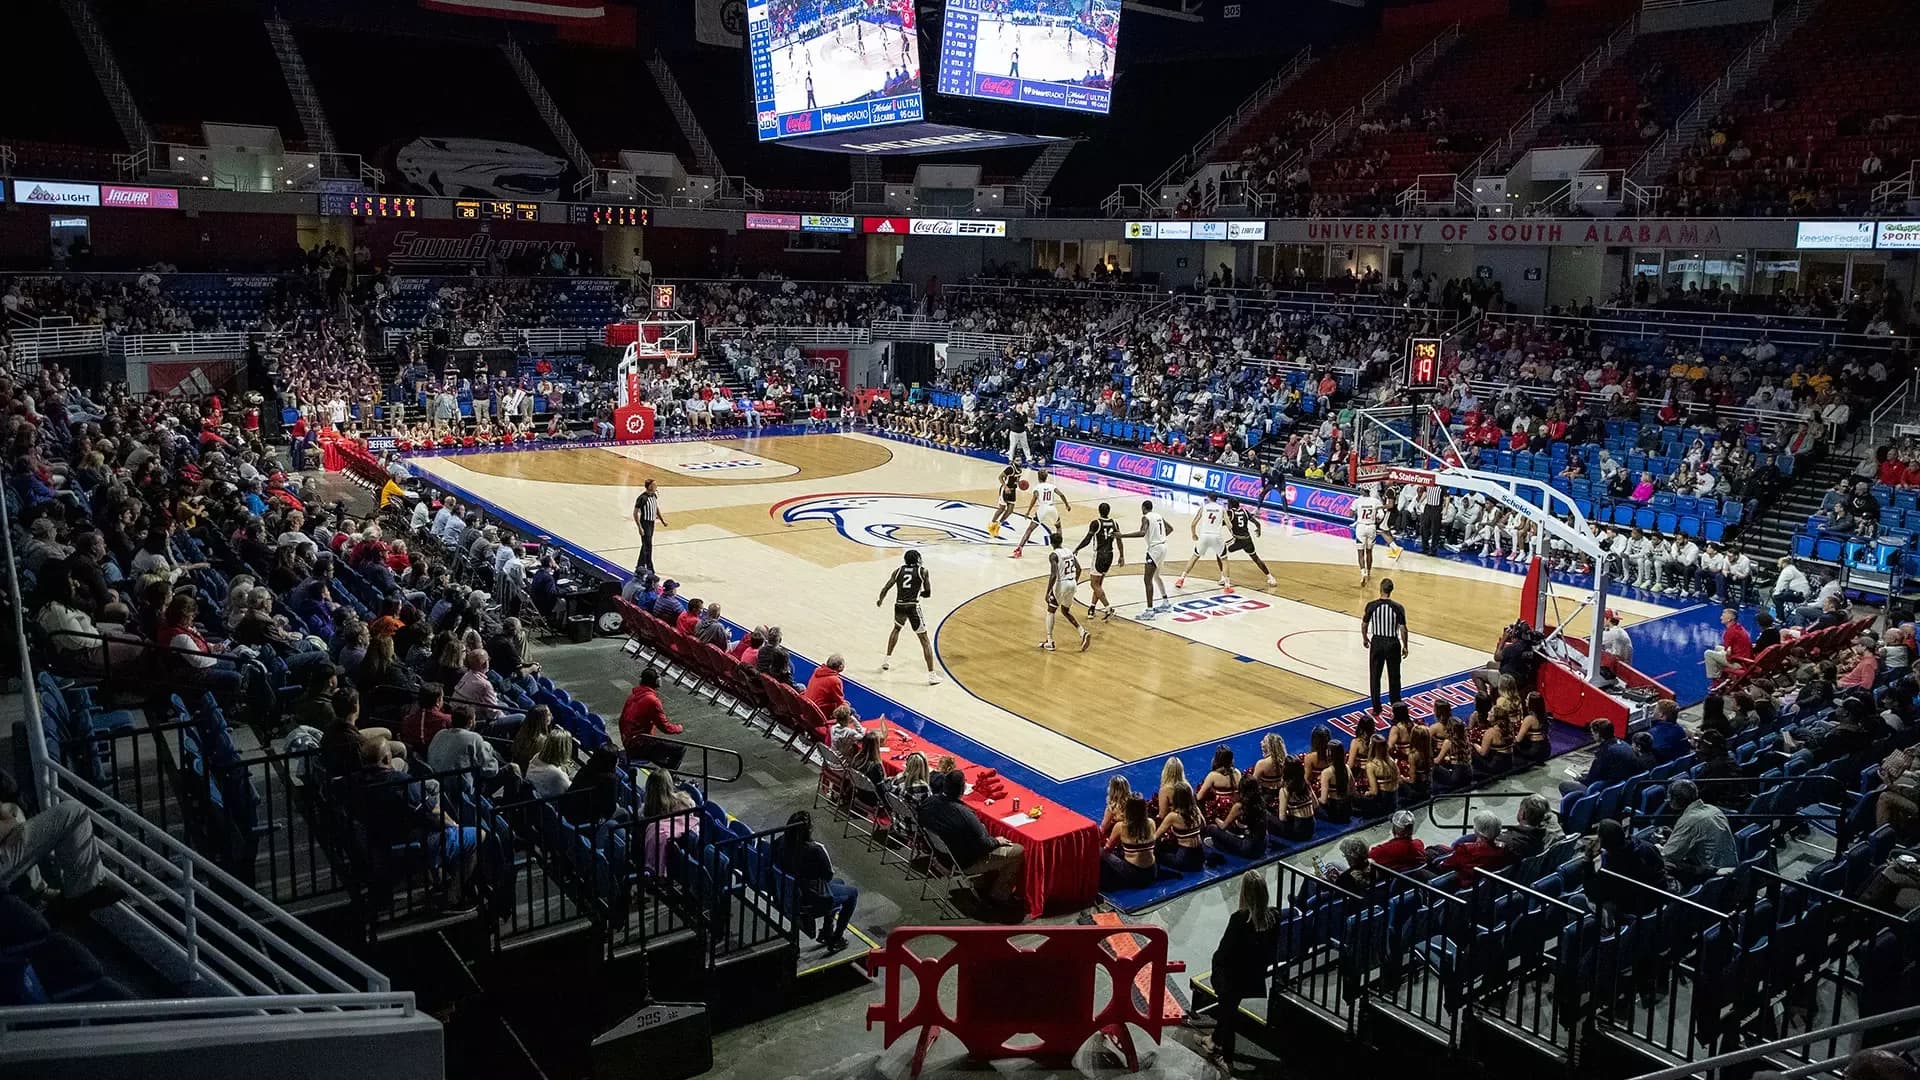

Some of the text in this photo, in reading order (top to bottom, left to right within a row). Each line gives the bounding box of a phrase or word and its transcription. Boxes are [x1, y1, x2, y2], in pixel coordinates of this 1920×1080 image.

[1225, 6, 1240, 17] 305
[981, 77, 1014, 96] Coca-Cola
[897, 97, 919, 110] ULTRA
[785, 113, 812, 133] Coca-Cola
[28, 190, 91, 203] Coors LIGHT
[105, 188, 150, 203] JAGUAR
[463, 208, 475, 217] 28
[490, 202, 512, 214] 7:45
[525, 211, 534, 220] 12
[819, 216, 849, 224] COOK'S
[913, 220, 953, 234] Coca-Cola
[1308, 223, 1721, 244] UNIVERSITY OF SOUTH ALABAMA
[1882, 232, 1920, 241] SPORT
[659, 294, 670, 307] 19
[1416, 343, 1436, 358] 7:45
[1418, 358, 1431, 382] 19
[368, 439, 396, 449] DEFENSE
[1056, 443, 1092, 465] Coca-Cola
[1117, 454, 1157, 478] Coca-Cola
[1161, 464, 1220, 488] 28 12
[1042, 490, 1052, 502] 10
[1306, 488, 1357, 517] Coca-Cola
[1500, 494, 1533, 518] Schelde
[1208, 512, 1217, 525] 4
[1361, 508, 1373, 520] 12
[1237, 516, 1244, 528] 5
[1063, 559, 1076, 575] 22
[902, 574, 913, 589] 2
